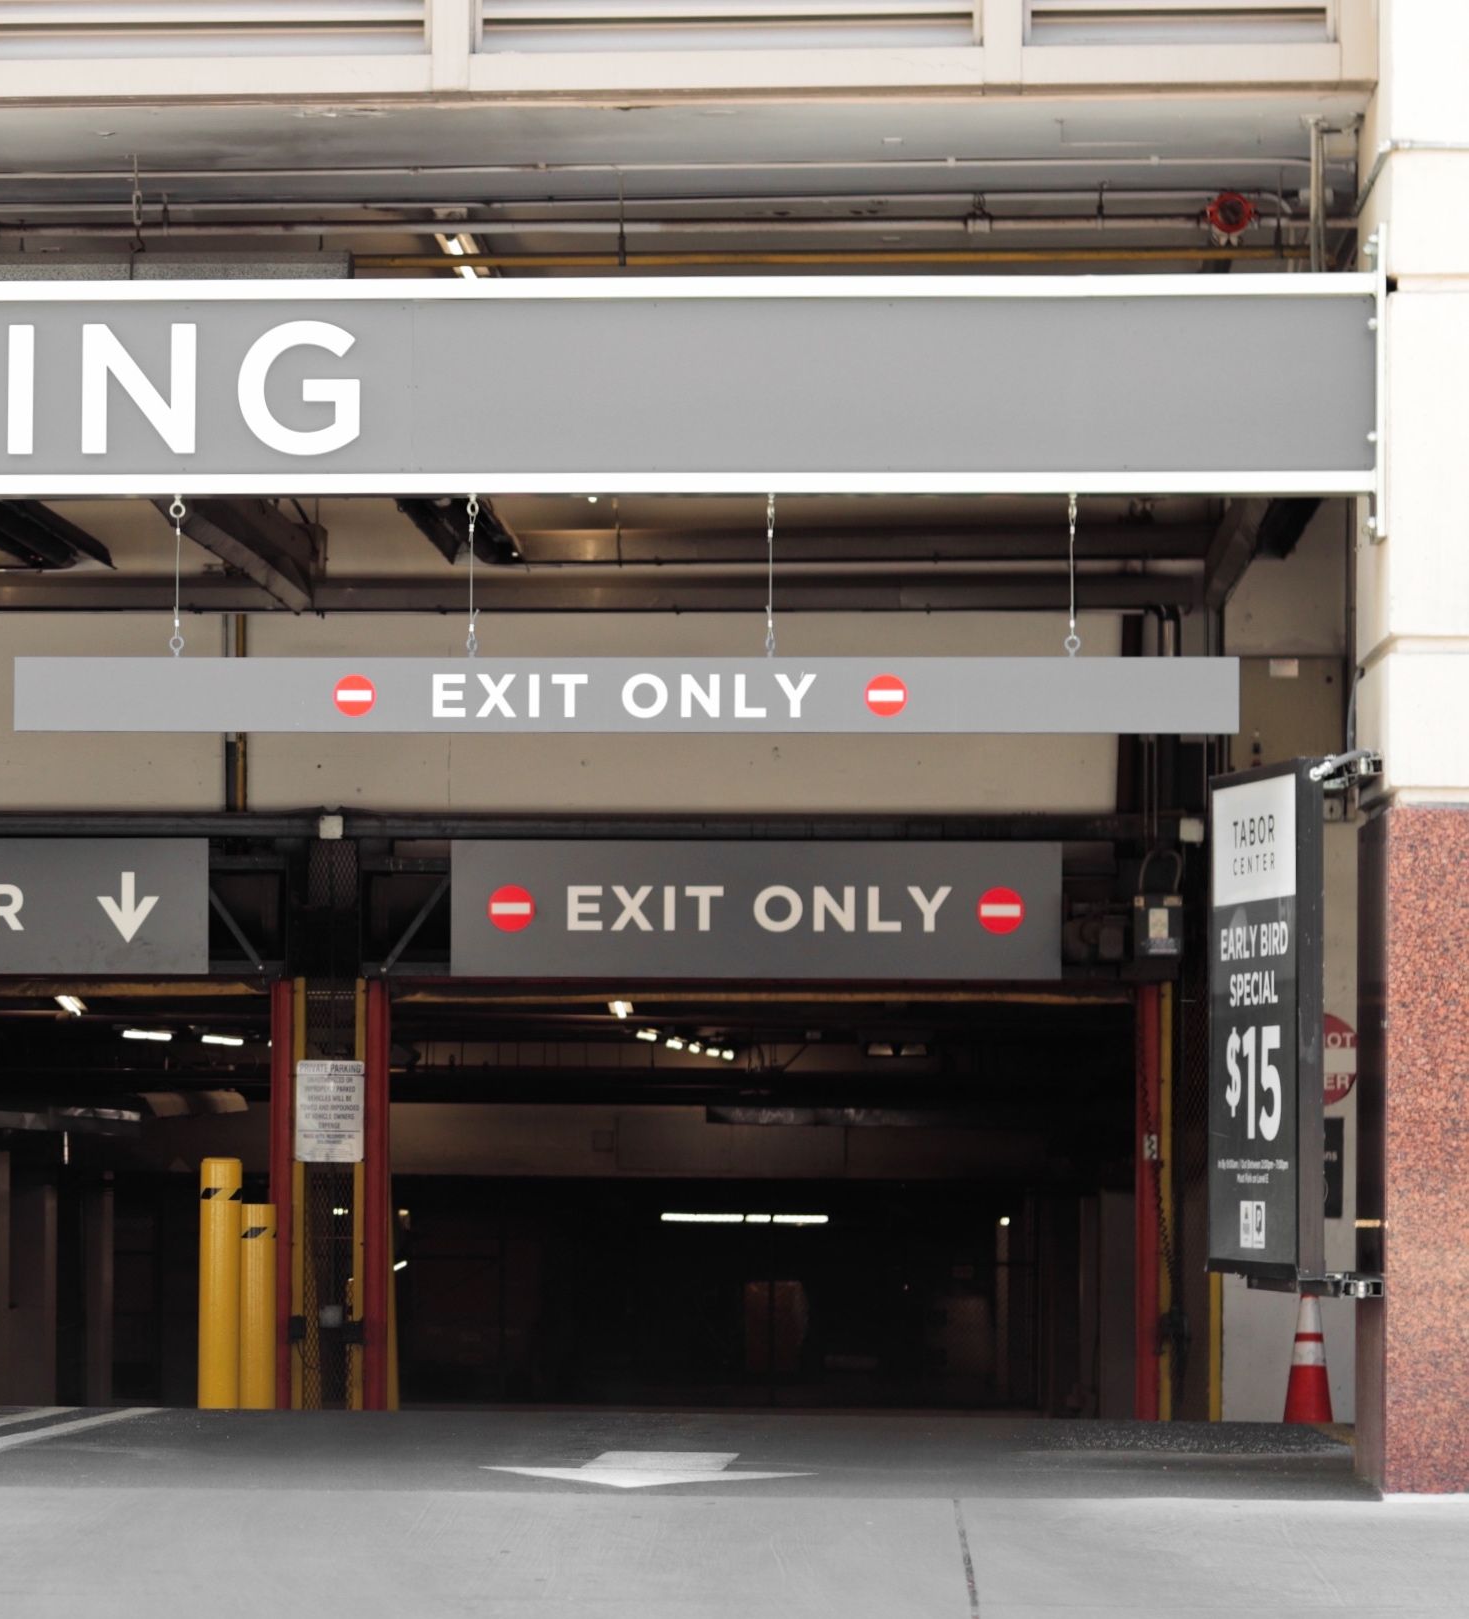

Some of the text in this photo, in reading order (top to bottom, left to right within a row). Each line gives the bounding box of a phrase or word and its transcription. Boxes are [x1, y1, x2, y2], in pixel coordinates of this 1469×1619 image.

[432, 672, 817, 719] EXIT ONLY
[1232, 814, 1276, 849] TABOR
[1233, 852, 1276, 876] CENTER
[567, 885, 952, 932] EXIT ONLY
[1221, 921, 1288, 961] EARLY BIRD
[1230, 970, 1278, 1007] SPECIAL
[1324, 1032, 1355, 1049] OT
[300, 1063, 362, 1074] PRIVATE PARKING
[1225, 1024, 1281, 1141] $15
[1324, 1073, 1349, 1090] ER
